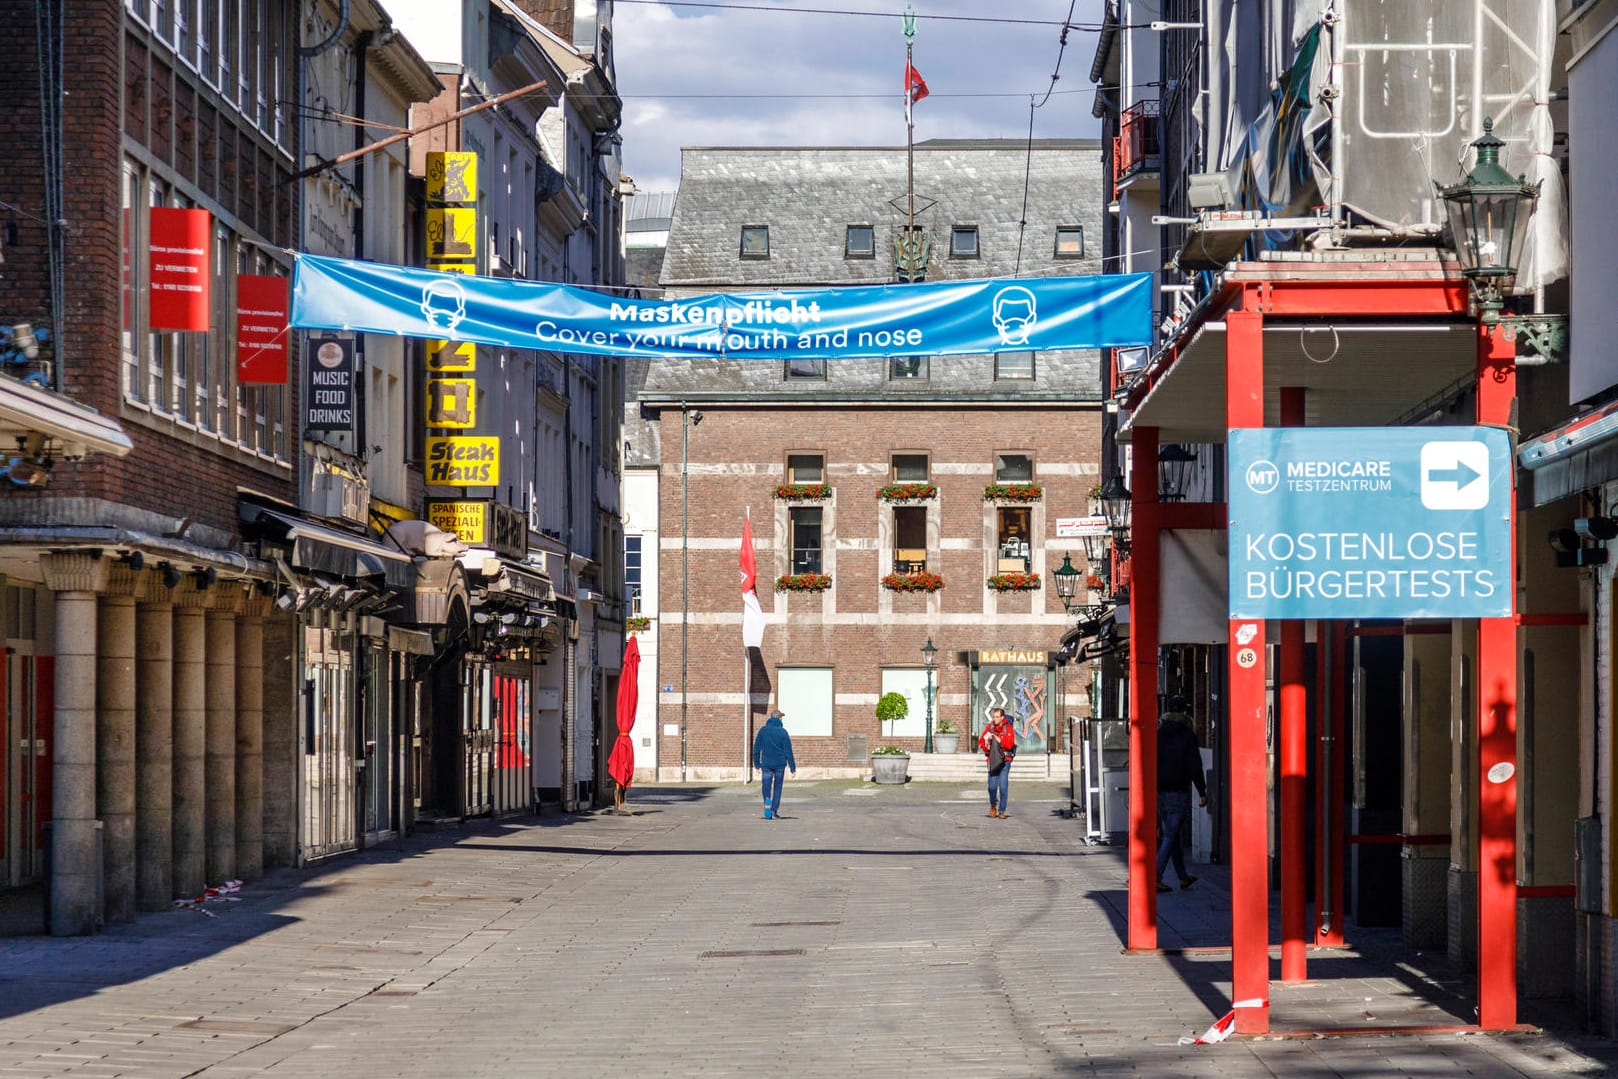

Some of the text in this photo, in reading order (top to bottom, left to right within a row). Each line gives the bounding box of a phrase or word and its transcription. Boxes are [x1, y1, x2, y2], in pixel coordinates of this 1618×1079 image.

[610, 299, 821, 326] Maskenpflicht
[536, 321, 922, 351] Cover your mouth and nose
[313, 371, 349, 386] MUSIC
[315, 390, 346, 405] FOOD
[309, 409, 352, 424] DRINKS
[430, 442, 495, 461] Steak
[431, 462, 491, 482] Haus
[1250, 461, 1391, 484] MT MEDICARE
[1287, 479, 1392, 493] TESTZENTRUM
[432, 504, 481, 514] SPANISCHE
[1246, 531, 1478, 562] KOSTENLOSE
[1247, 565, 1495, 599] BÜRGERTESTS
[981, 651, 1044, 663] RATHAUS
[1240, 652, 1254, 664] 68
